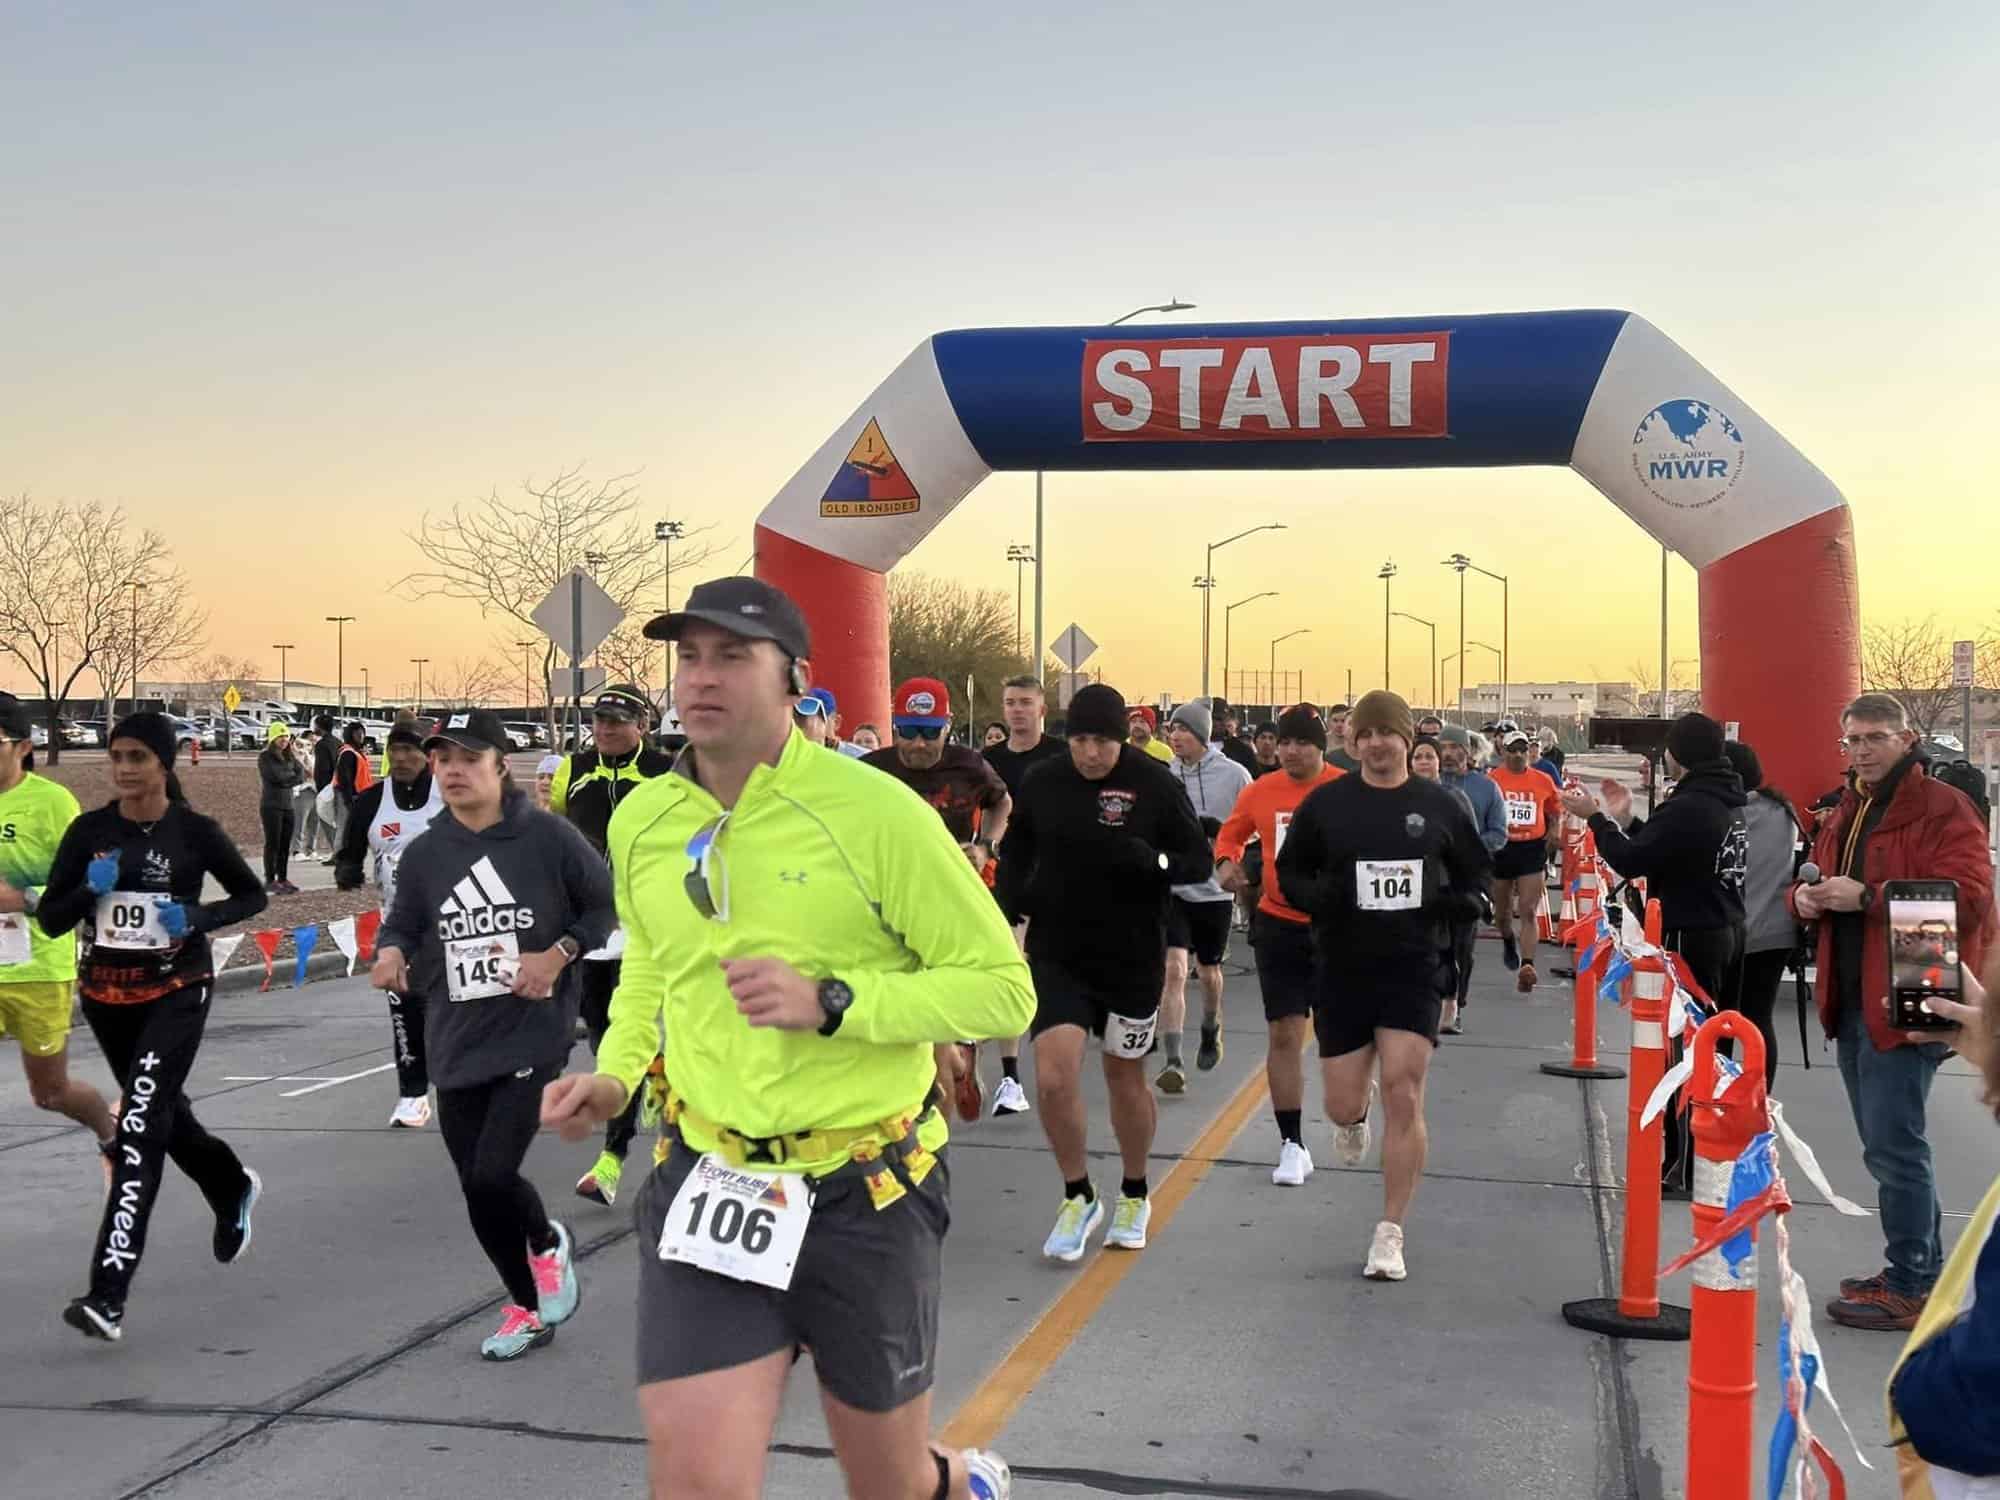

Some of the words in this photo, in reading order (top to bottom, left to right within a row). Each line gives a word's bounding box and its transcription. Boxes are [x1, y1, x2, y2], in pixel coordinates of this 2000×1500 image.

[1093, 342, 1436, 432] START
[1684, 450, 1713, 458] ARMY
[1650, 460, 1728, 480] MWR
[825, 503, 849, 513] OLD
[855, 501, 914, 513] IRONSIDES
[1510, 809, 1531, 820] 150
[1370, 878, 1411, 898] 104
[113, 905, 145, 928] 09
[438, 905, 534, 940] adidas
[455, 957, 501, 987] 149
[1122, 1032, 1149, 1050] 32
[122, 1075, 156, 1133] one
[102, 1180, 142, 1272] week
[686, 1192, 776, 1254] 106
